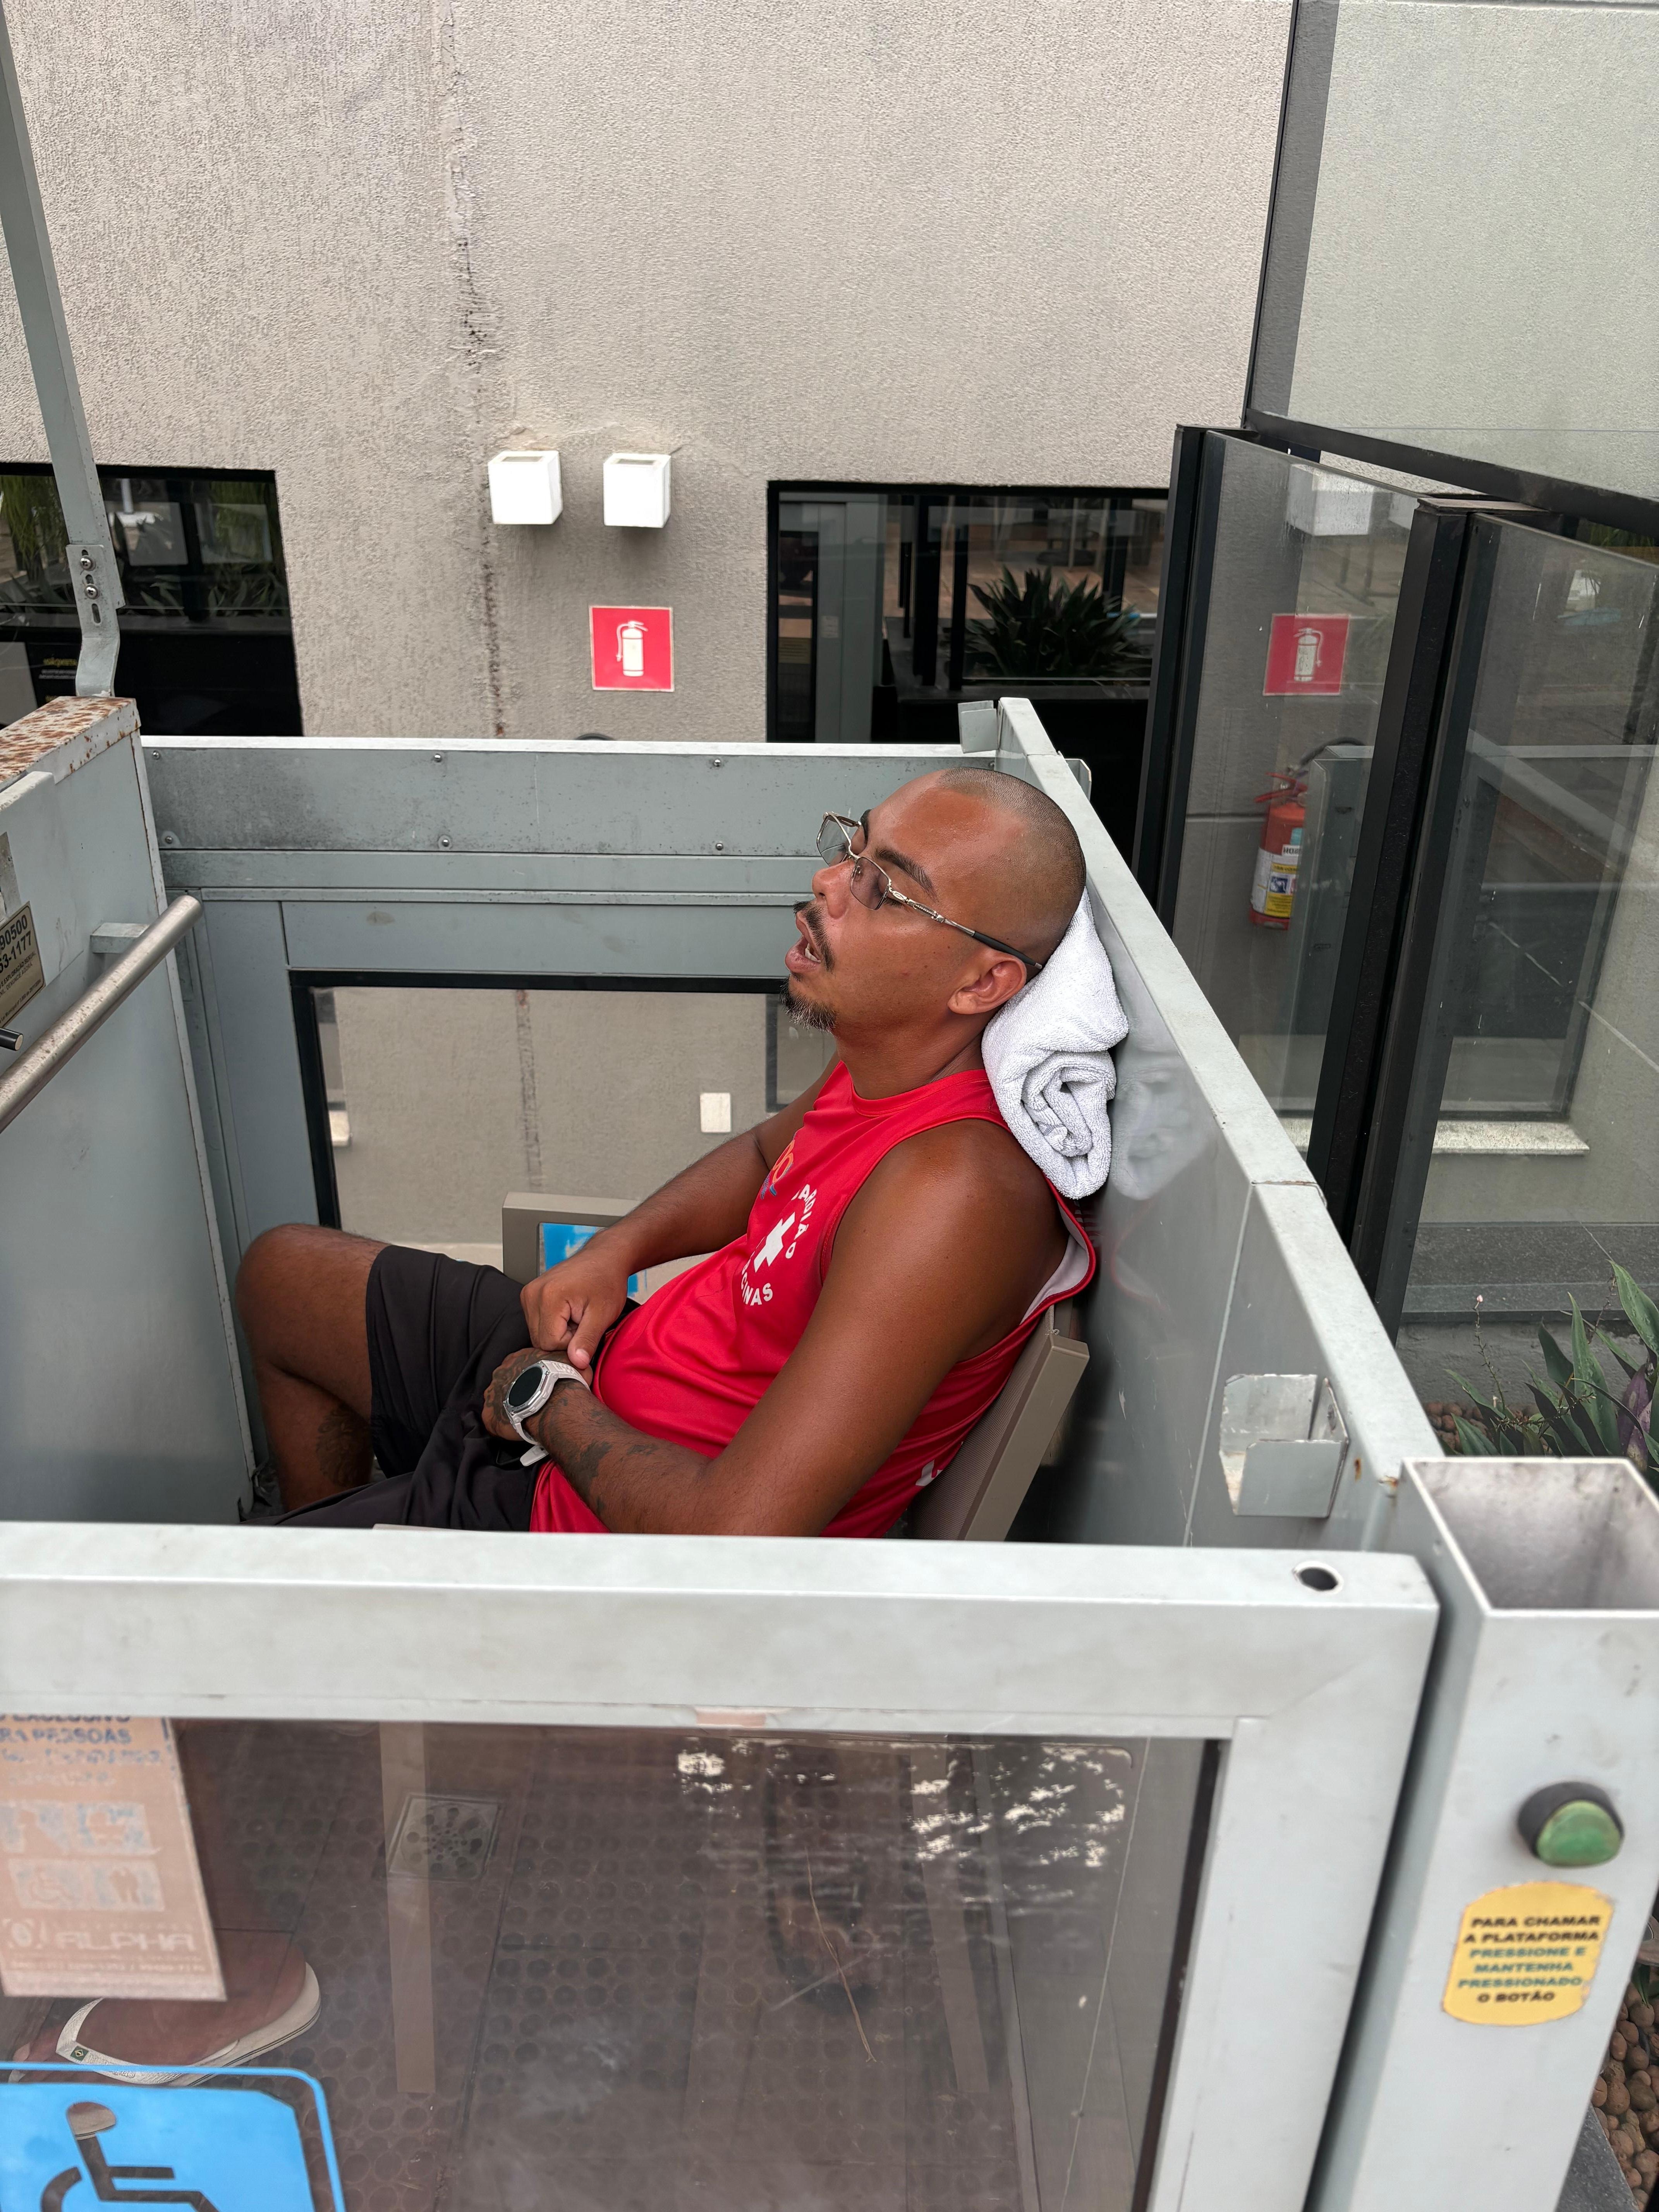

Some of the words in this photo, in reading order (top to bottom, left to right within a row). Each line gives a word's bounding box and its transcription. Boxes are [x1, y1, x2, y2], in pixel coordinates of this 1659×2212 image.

[1472, 1917, 1517, 1927] PARA
[1524, 1916, 1601, 1927] CHAMAR
[1464, 1934, 1475, 1943] A
[1481, 1932, 1599, 1943] PLATAFORMA
[1470, 1948, 1569, 1958] PRESSIONE
[1475, 1962, 1573, 1972] MANTENHA
[1458, 1977, 1583, 1988] PRESSIONADO
[1477, 1993, 1490, 2002] O
[1496, 1990, 1555, 2002] BOTÃO
